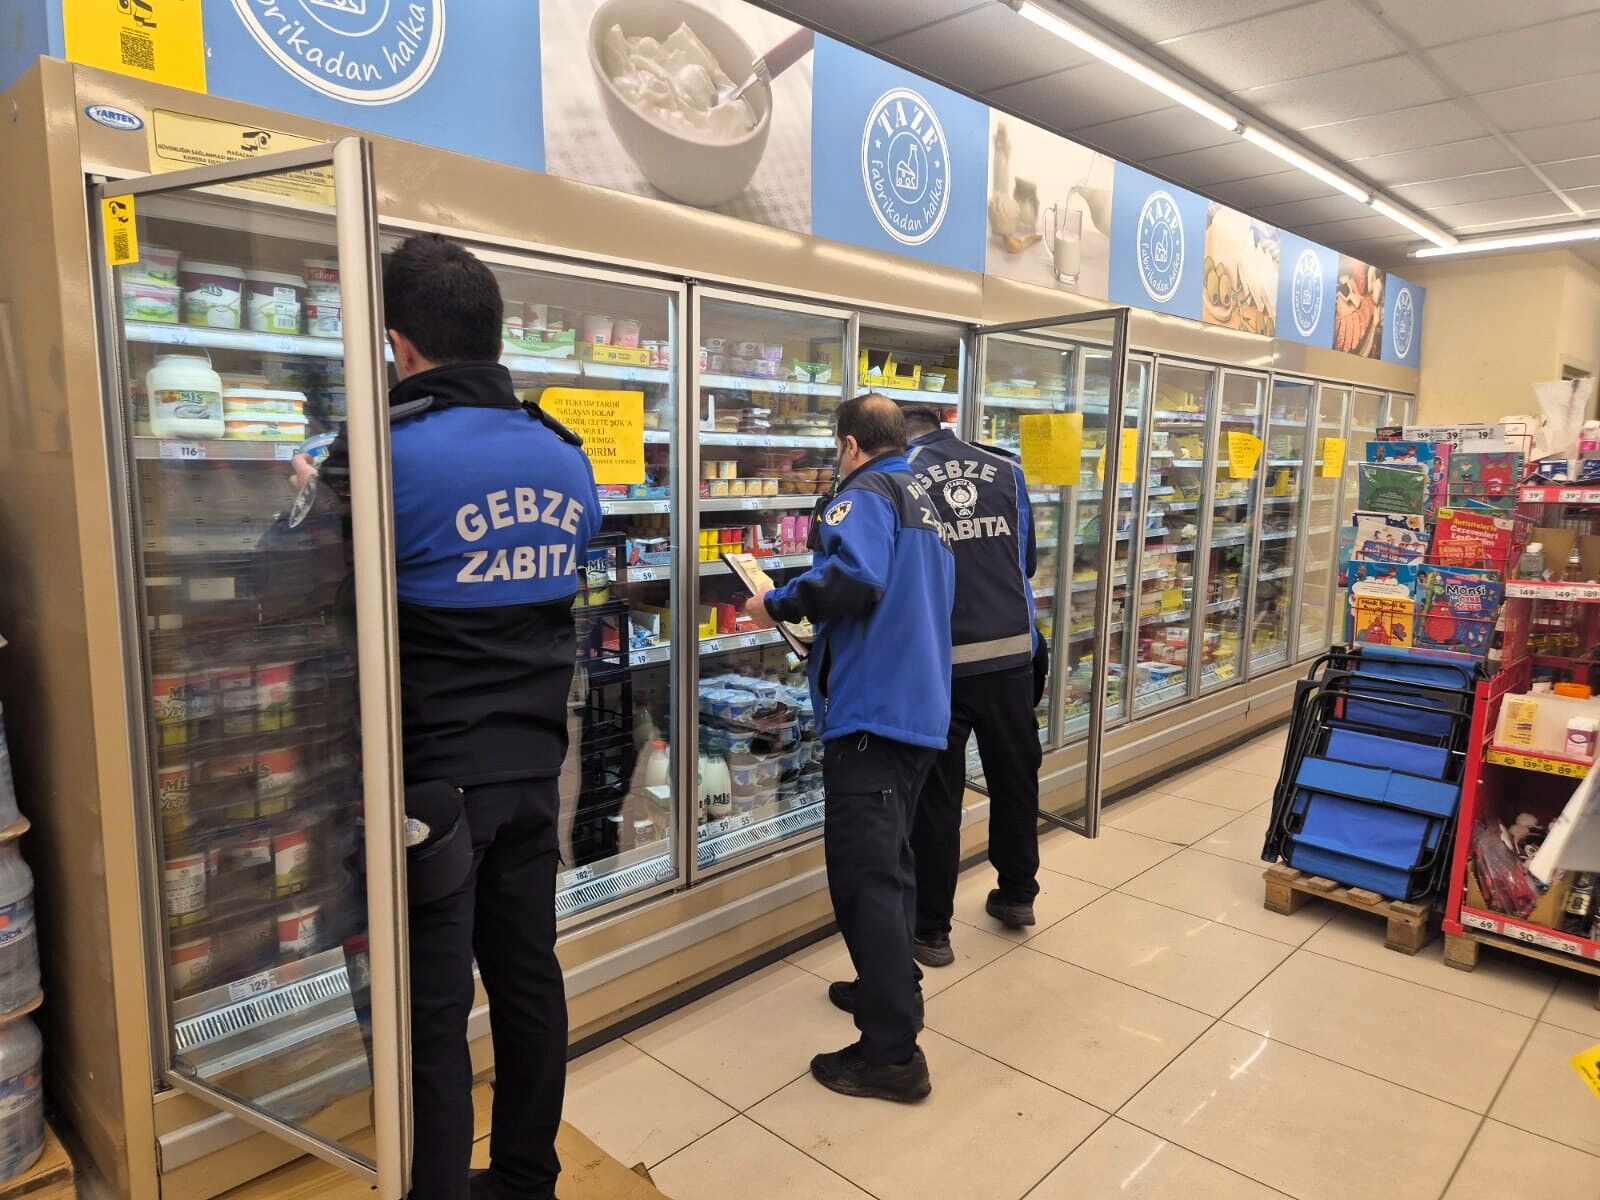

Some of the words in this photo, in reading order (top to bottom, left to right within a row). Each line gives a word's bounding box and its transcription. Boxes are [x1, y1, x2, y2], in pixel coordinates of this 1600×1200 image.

[257, 0, 382, 82] rikadan
[382, 3, 426, 74] halka
[877, 100, 939, 153] TAZE
[871, 159, 923, 232] fabrikadan
[923, 177, 943, 223] halka
[455, 487, 585, 542] GEBZE
[456, 543, 577, 583] ZABITA
[1445, 584, 1487, 596] Monsi
[719, 821, 730, 832] 59
[575, 870, 590, 880] 182
[1480, 921, 1493, 929] 69
[250, 978, 268, 992] 129
